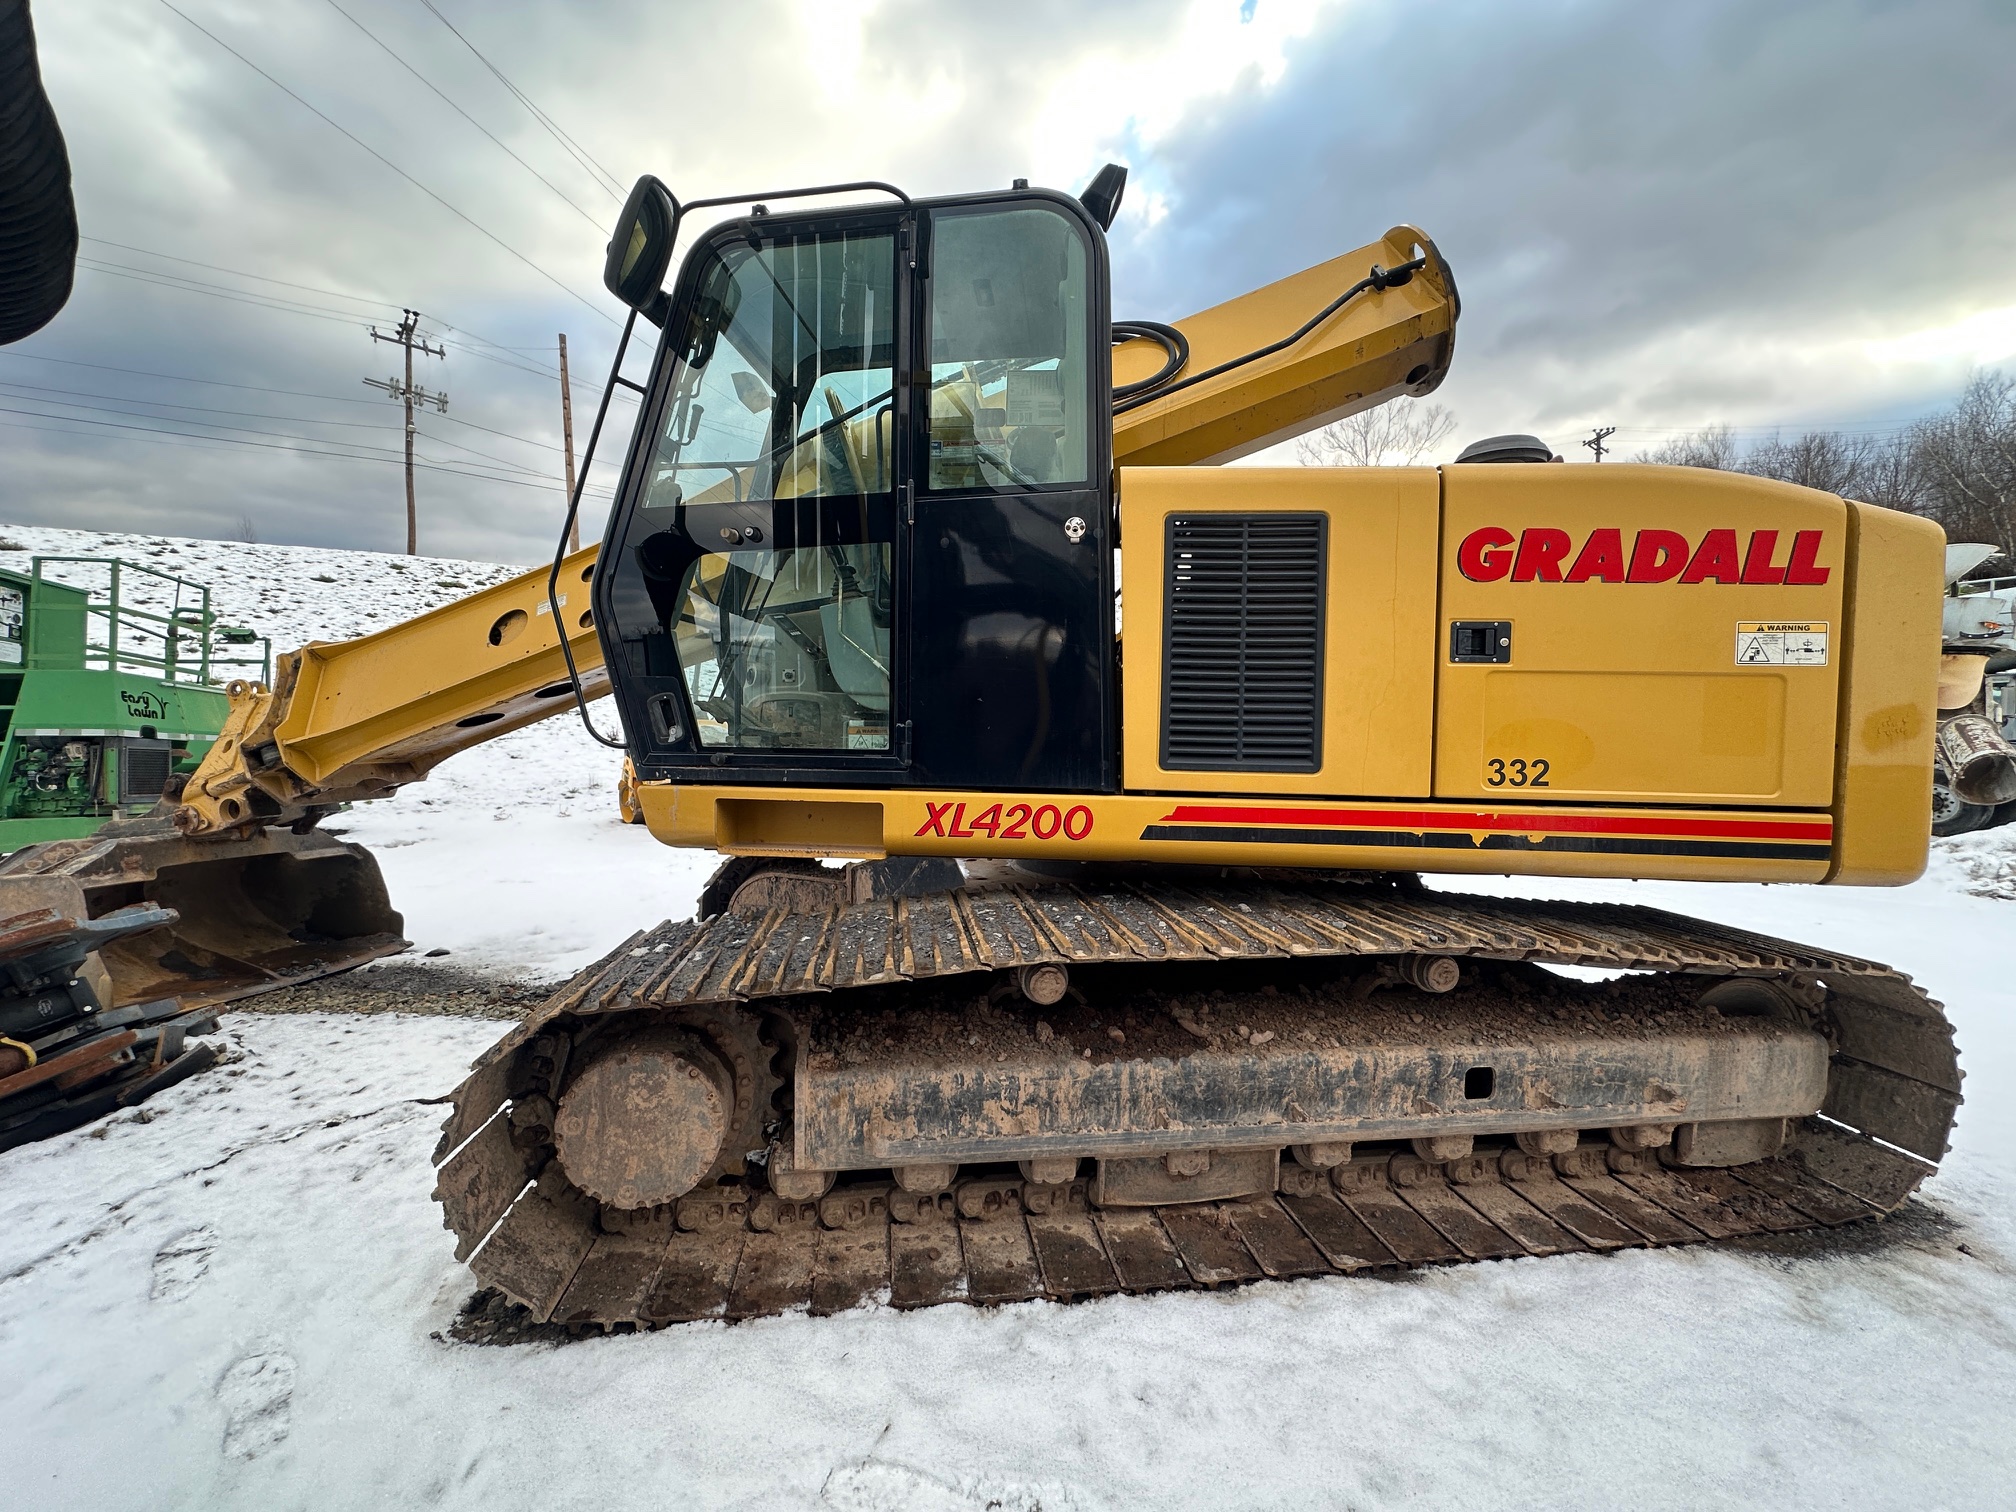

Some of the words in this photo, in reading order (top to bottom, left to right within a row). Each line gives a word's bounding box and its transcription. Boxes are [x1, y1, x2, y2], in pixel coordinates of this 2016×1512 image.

[1457, 526, 1831, 585] GRADALL
[1766, 624, 1811, 632] WARNING
[120, 690, 149, 709] Easy
[127, 704, 159, 719] Lawn
[1487, 758, 1550, 787] 332
[913, 802, 1094, 841] XL4200
